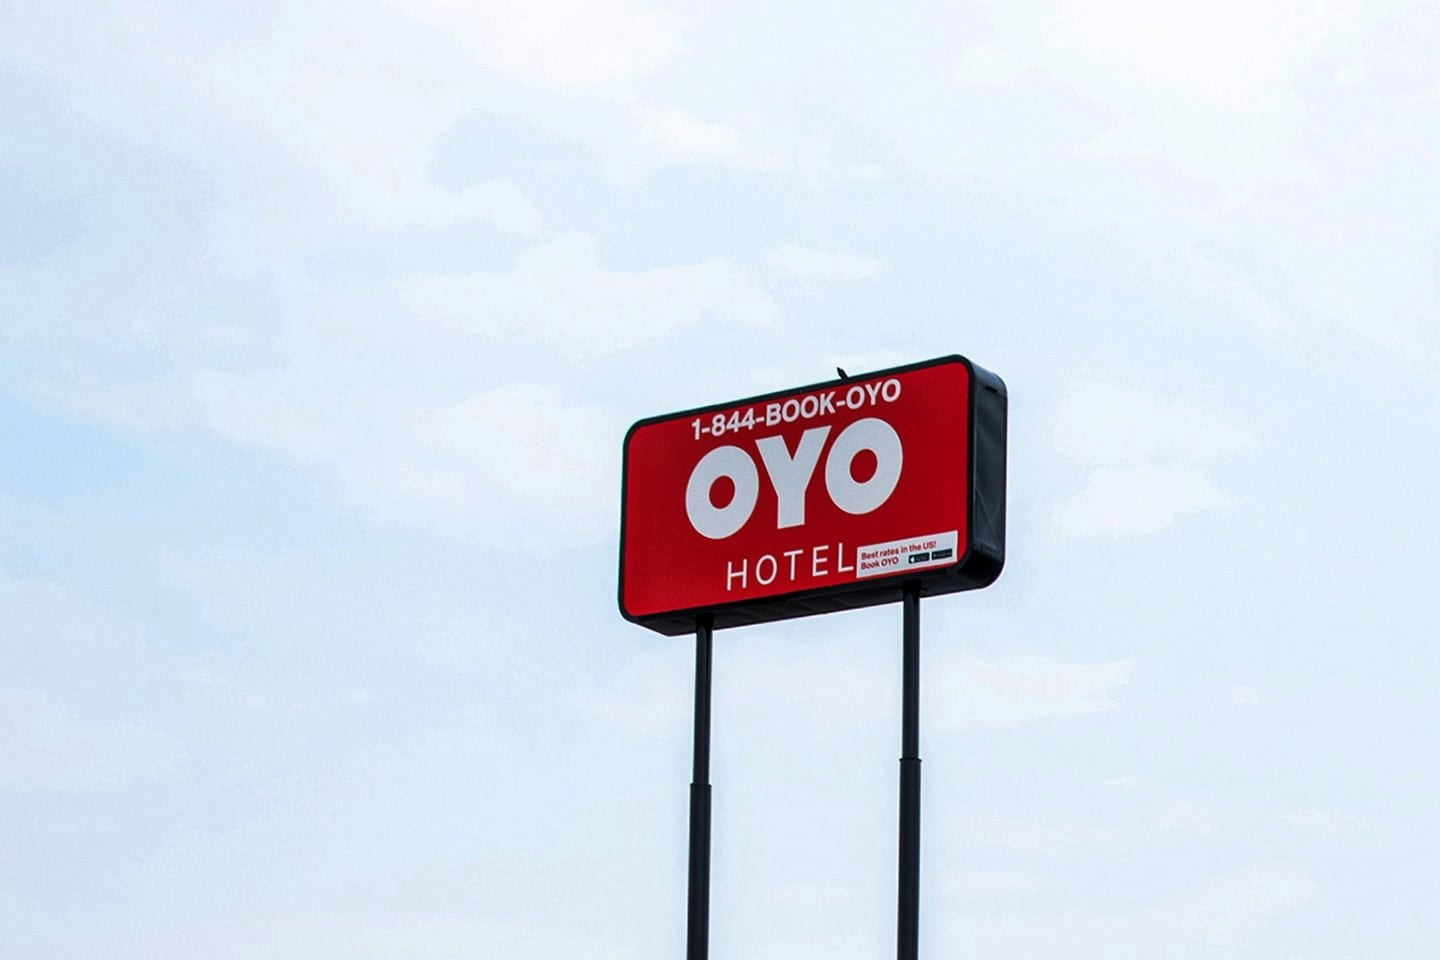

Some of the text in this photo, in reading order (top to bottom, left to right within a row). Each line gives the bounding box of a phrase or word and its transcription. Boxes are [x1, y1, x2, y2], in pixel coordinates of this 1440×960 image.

[692, 378, 901, 440] 1-844-BOOK-OYO
[685, 417, 904, 540] OYO
[726, 543, 854, 591] HOTEL
[861, 540, 937, 560] Best rates in the US!
[861, 556, 899, 569] Book OYO
